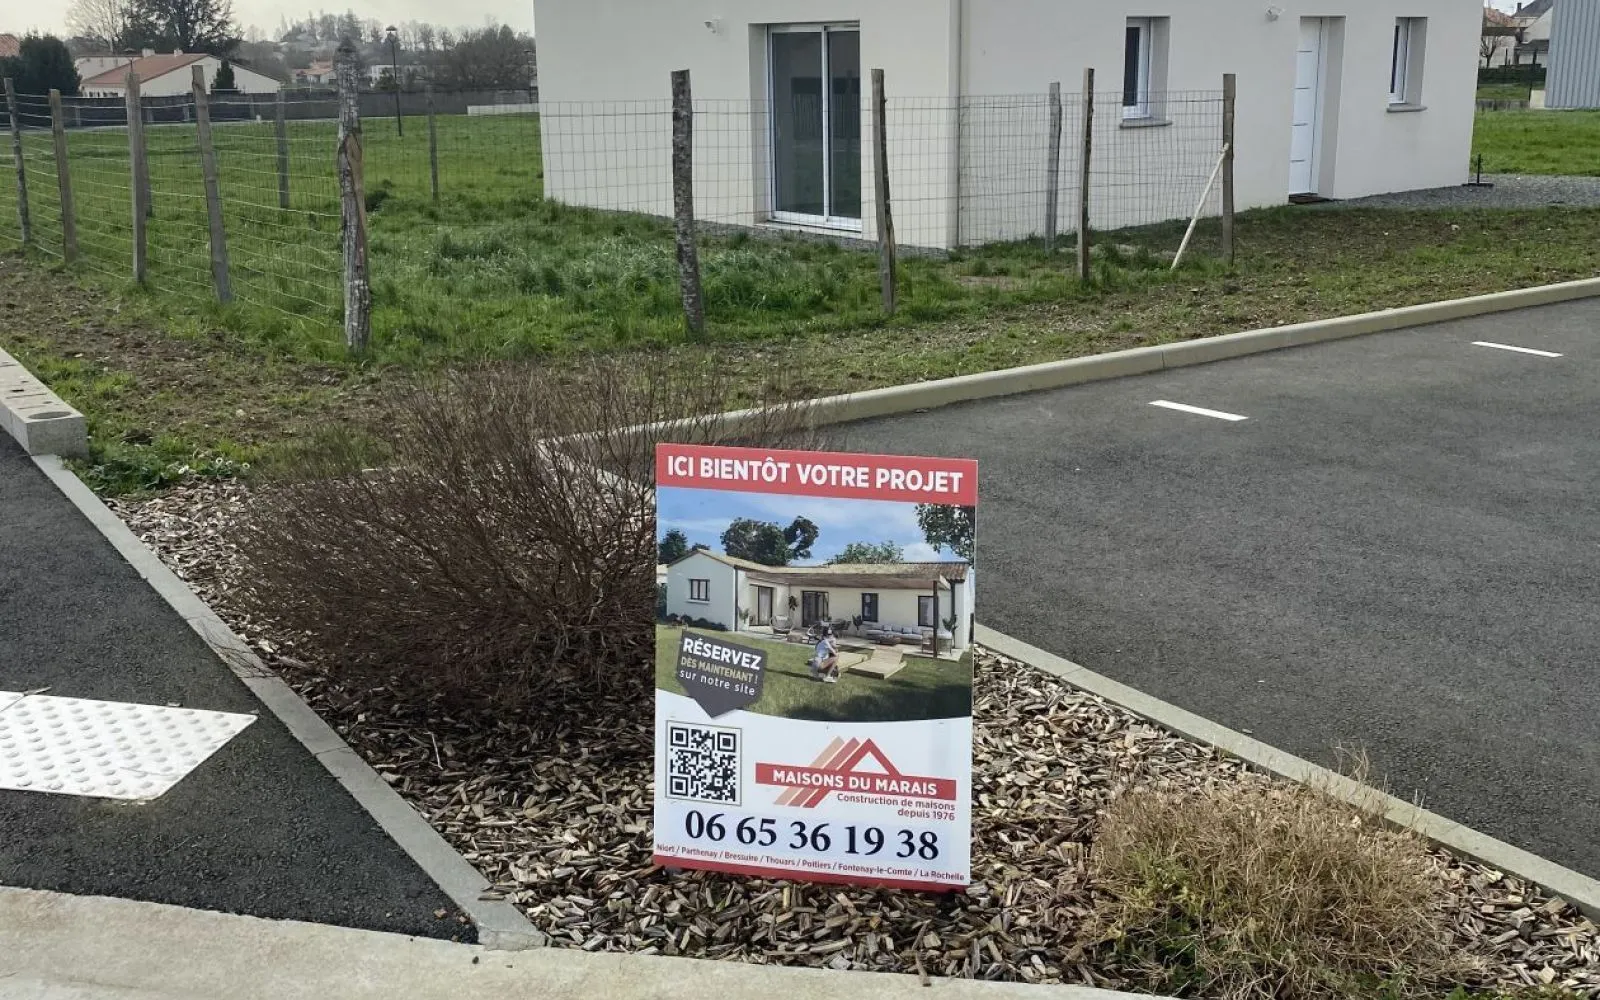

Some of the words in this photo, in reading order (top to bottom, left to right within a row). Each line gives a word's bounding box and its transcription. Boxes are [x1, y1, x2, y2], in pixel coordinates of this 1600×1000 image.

[667, 455, 694, 477] ICI
[700, 456, 790, 483] BIENTÔT
[796, 463, 870, 489] VOTRE
[875, 468, 963, 493] PROJET
[683, 637, 761, 670] RÉSERVEZ
[680, 670, 696, 681] sur
[700, 675, 730, 689] notre
[734, 683, 755, 696] site
[698, 660, 753, 683] MAINTENANT
[773, 769, 843, 787] MAISONS
[849, 777, 870, 790] DU
[876, 779, 937, 796] MARAIS
[837, 793, 898, 806] Construction
[901, 799, 913, 807] de
[915, 801, 955, 811] maisons
[897, 808, 930, 820] depuis
[932, 811, 955, 821] 1976
[685, 810, 726, 841] 06
[736, 817, 777, 846] 65
[789, 821, 831, 851] 36
[845, 825, 885, 856] 19
[896, 829, 939, 860] 38
[681, 847, 718, 858] Parthenay
[766, 856, 796, 866] Thouars
[802, 860, 831, 870] Poitiers
[838, 864, 913, 876] Fontenay-le-Comte
[920, 869, 930, 877] La
[931, 871, 965, 881] Rochelle
